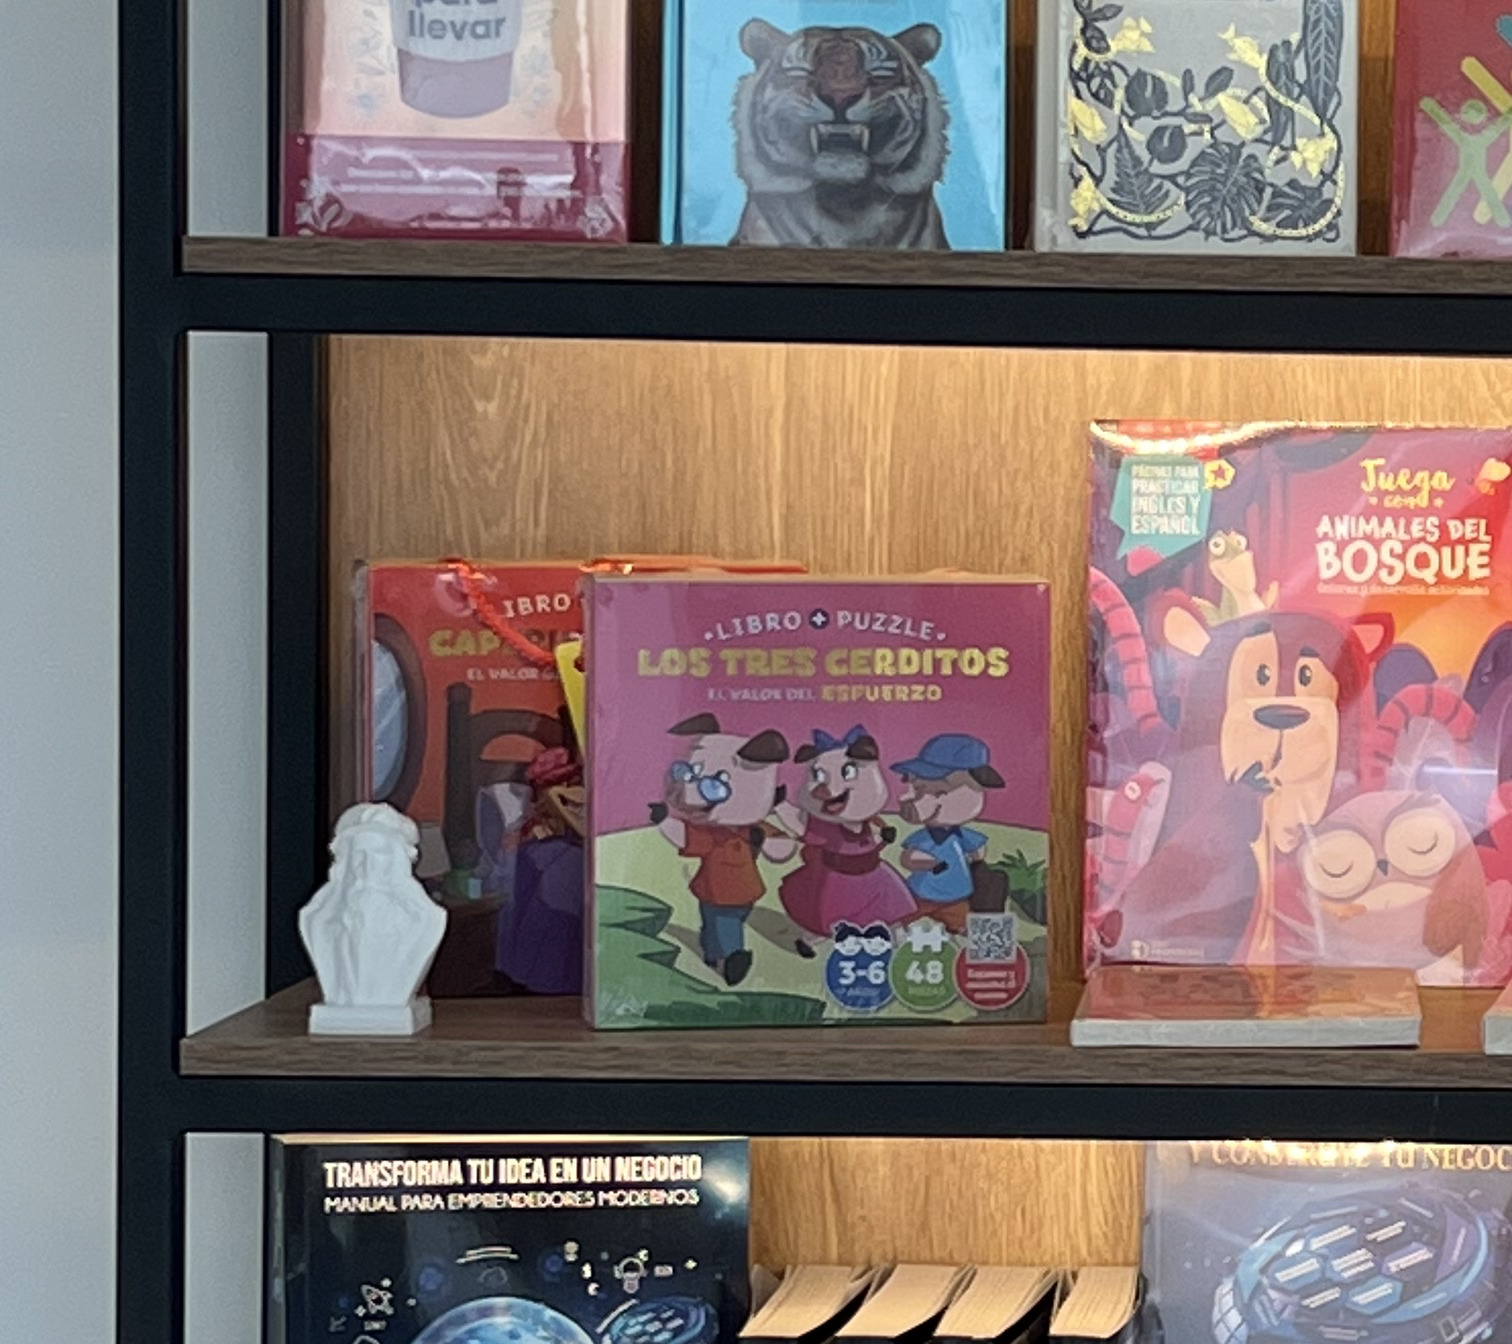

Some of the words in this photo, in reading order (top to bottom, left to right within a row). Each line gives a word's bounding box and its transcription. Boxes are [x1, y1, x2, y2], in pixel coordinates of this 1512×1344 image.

[408, 3, 506, 42] llevar
[1359, 457, 1456, 508] Juega
[1316, 514, 1441, 543] ANIMALES
[1447, 518, 1492, 543] DEL
[1316, 539, 1492, 585] BOSQUE
[637, 647, 712, 677] LOS
[720, 647, 816, 677] TRES
[826, 647, 1010, 677] CERDITOS
[838, 960, 886, 984] 3-6
[905, 960, 944, 984] 48
[323, 1160, 463, 1188] TRANSFORMA
[468, 1159, 493, 1185] TU
[499, 1158, 545, 1184] IDEA
[552, 1158, 577, 1183] EN
[583, 1157, 609, 1182] UN
[615, 1155, 702, 1182] NEGOCIO
[323, 1196, 397, 1214] MANUAL
[402, 1195, 444, 1212] PARA
[448, 1191, 594, 1211] EMPRENDEDORES
[598, 1189, 700, 1208] MODERNOS
